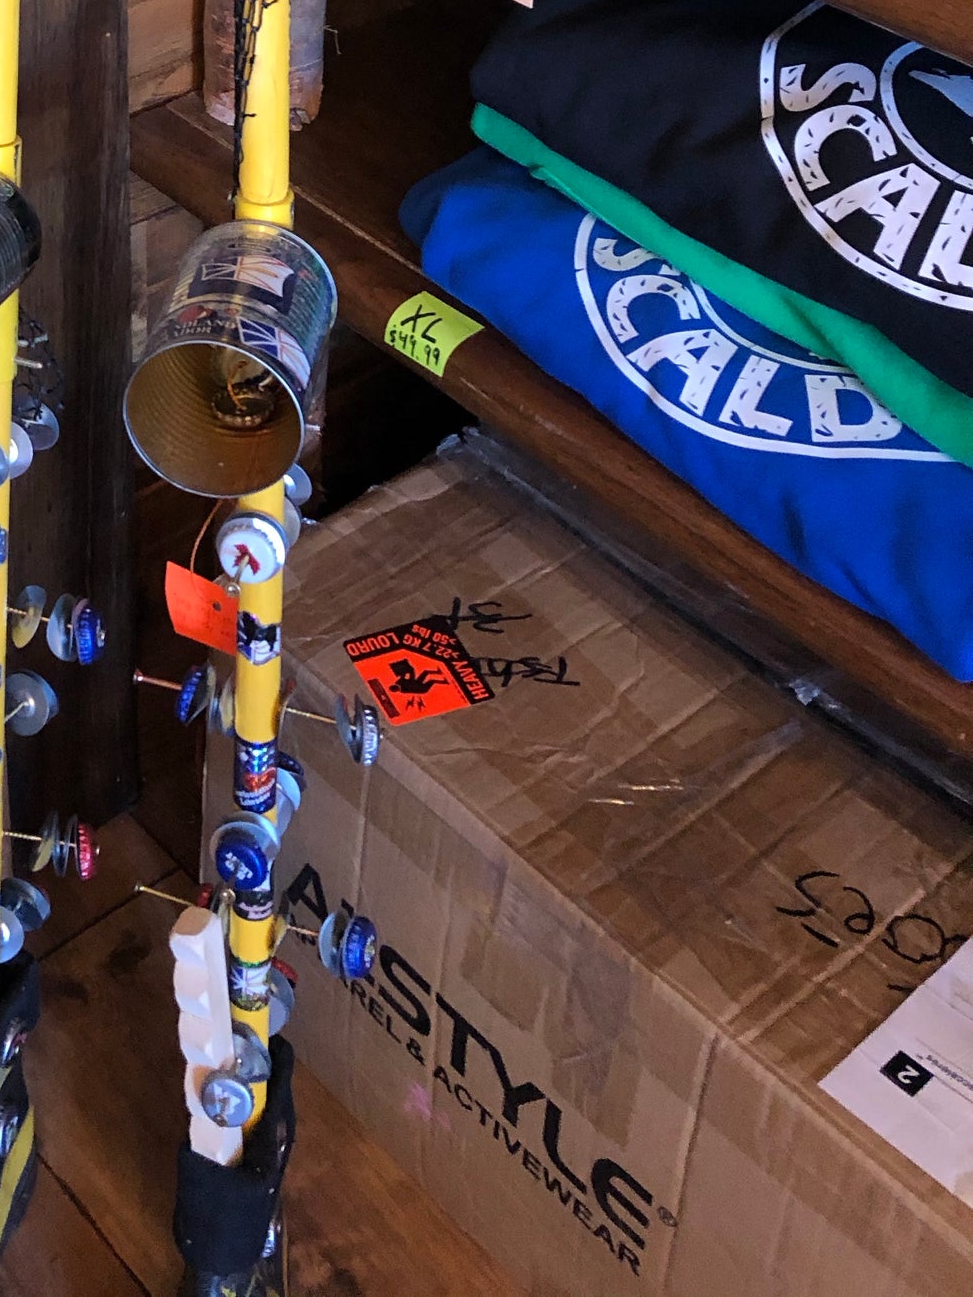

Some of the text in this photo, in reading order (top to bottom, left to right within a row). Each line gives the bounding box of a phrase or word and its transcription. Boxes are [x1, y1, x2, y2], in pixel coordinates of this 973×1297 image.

[400, 303, 443, 344] XL
[345, 630, 400, 656] LOURD
[402, 632, 424, 649] KG
[452, 660, 490, 701] HEAVY
[282, 862, 654, 1251] ASTYLE
[433, 1064, 643, 1278] ACTIVEWEAR
